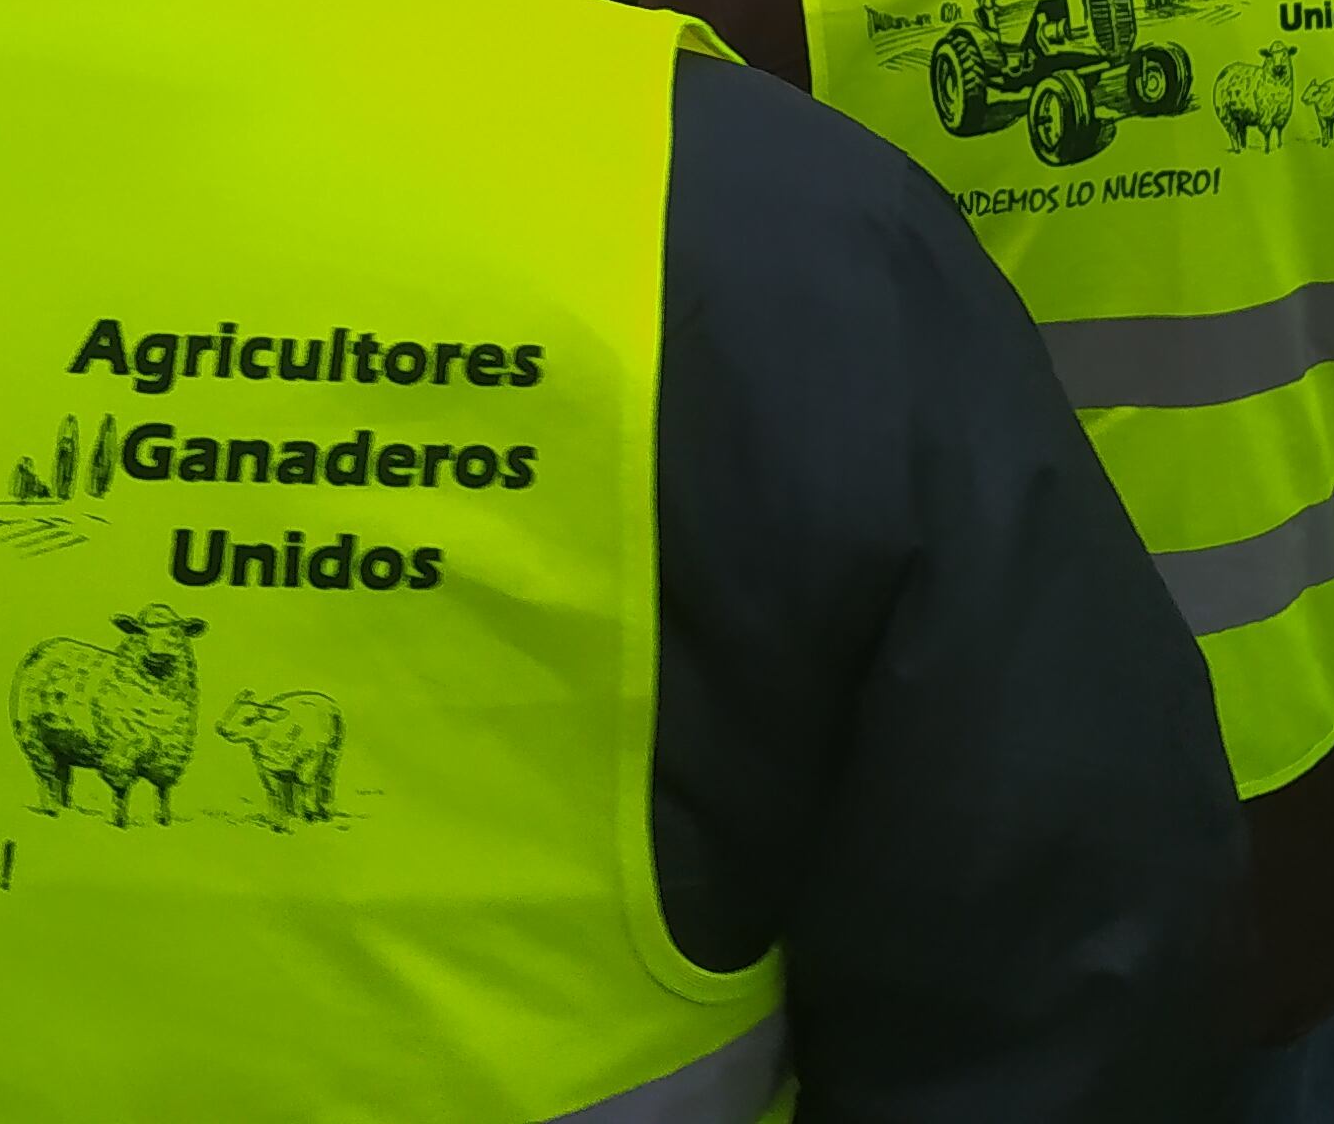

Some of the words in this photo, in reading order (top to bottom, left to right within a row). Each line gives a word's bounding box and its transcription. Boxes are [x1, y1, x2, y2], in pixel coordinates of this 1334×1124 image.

[951, 184, 1060, 217] NDEMOS
[1065, 180, 1096, 208] LO
[1102, 167, 1222, 204] NUESTRO!
[67, 318, 547, 395] Agricultores
[120, 422, 539, 490] Ganaderos
[169, 528, 447, 590] Unidos
